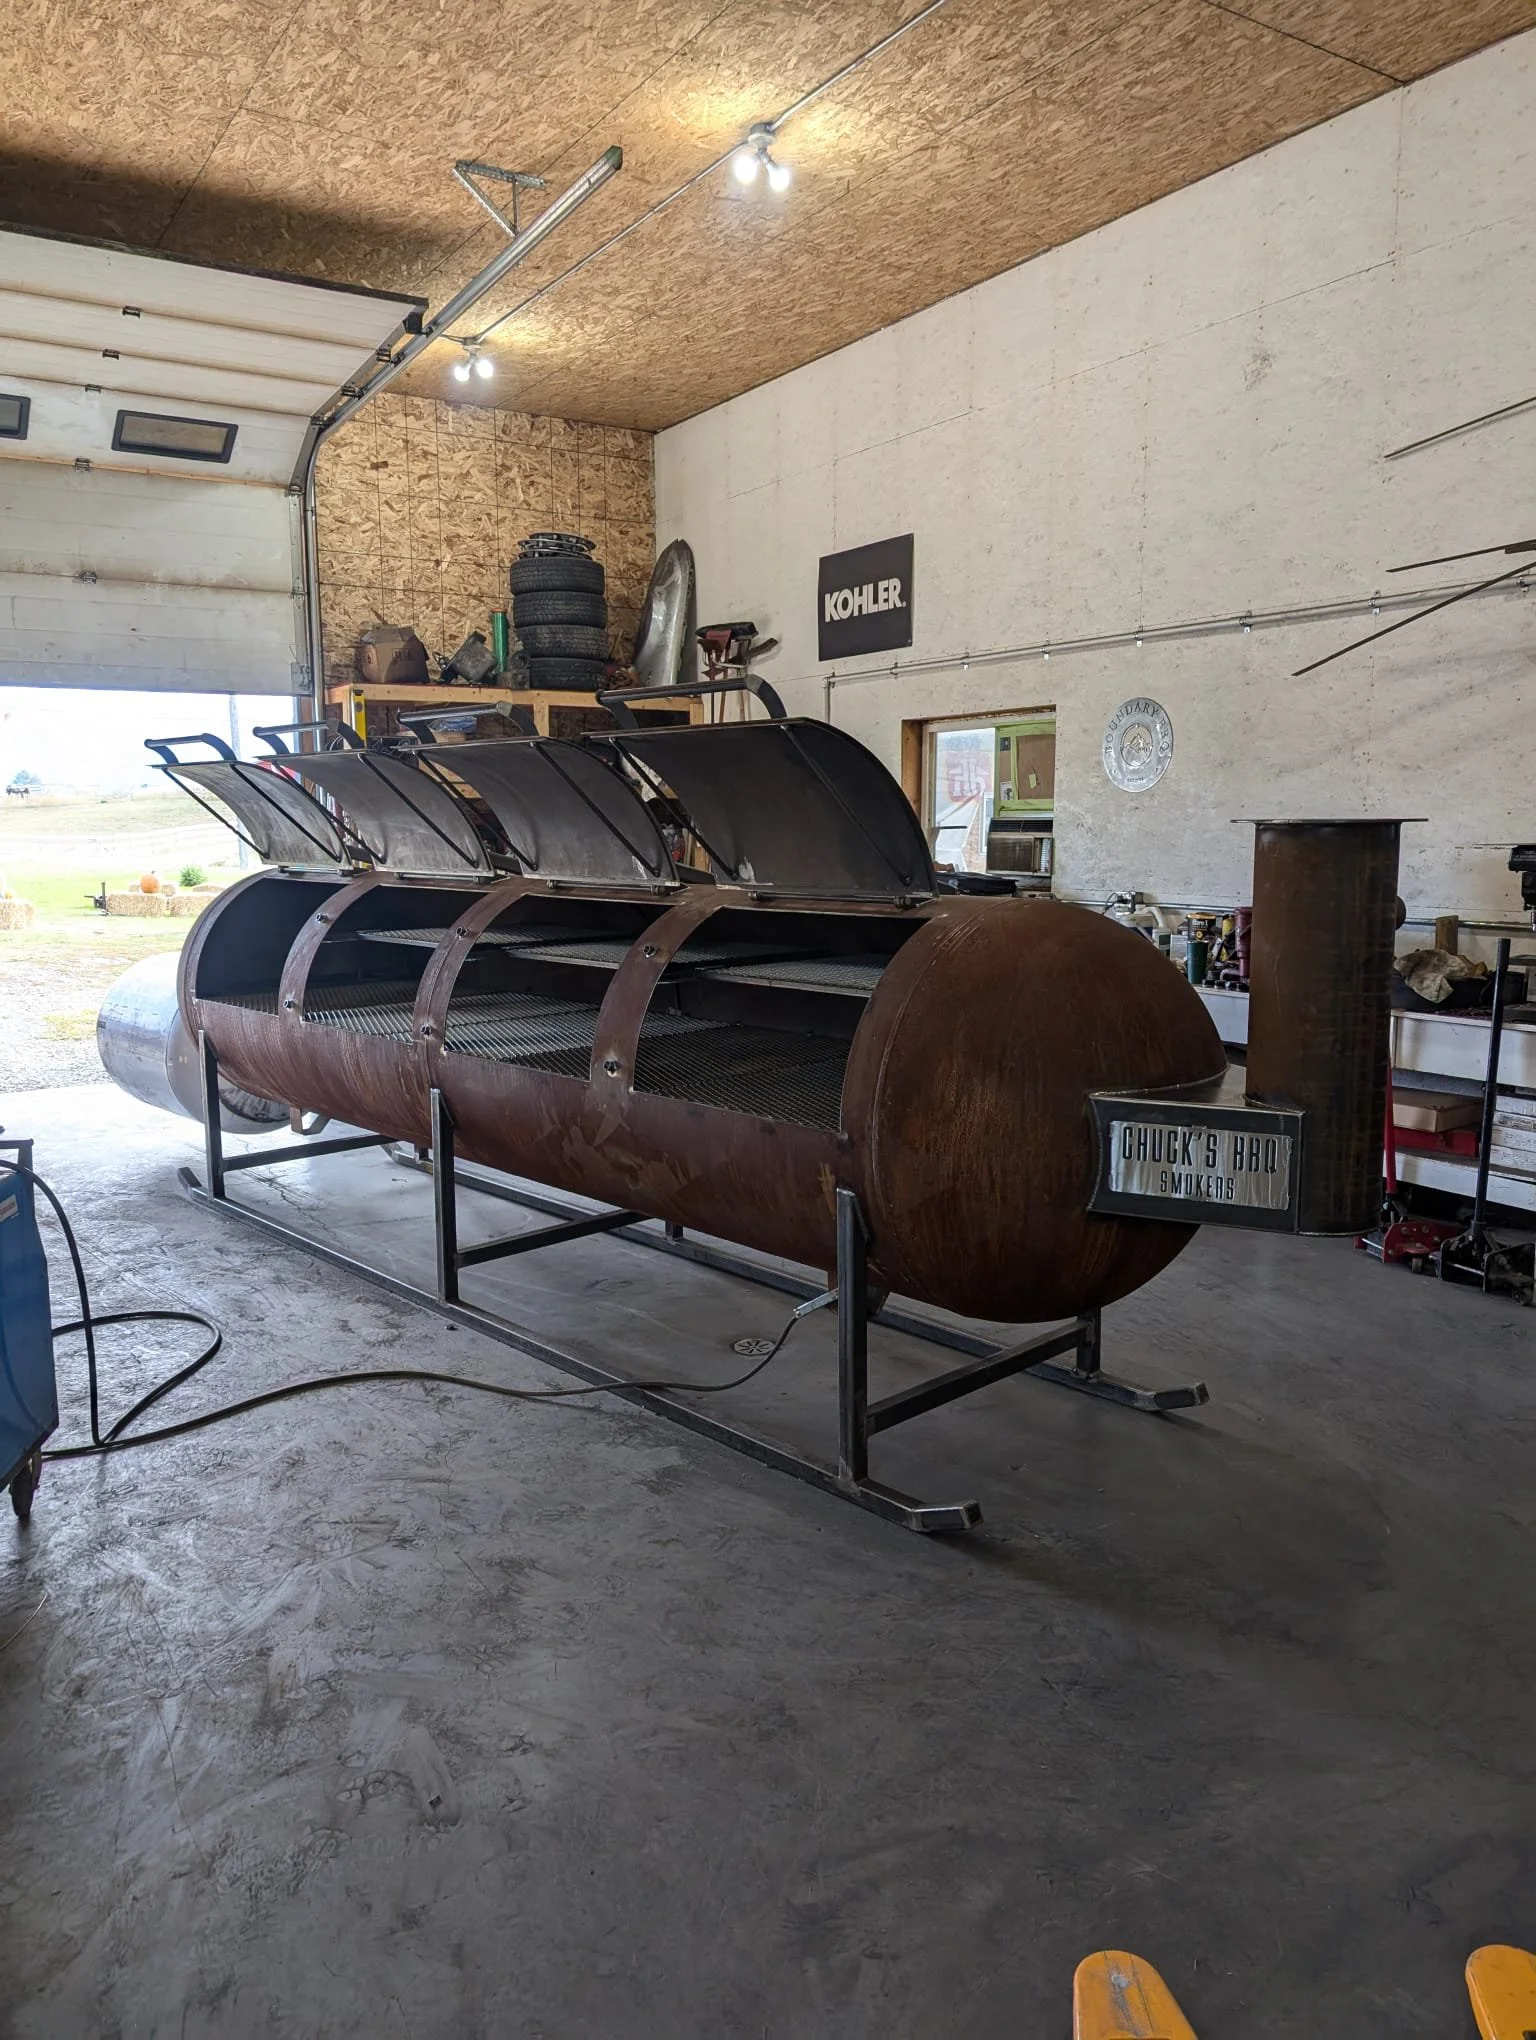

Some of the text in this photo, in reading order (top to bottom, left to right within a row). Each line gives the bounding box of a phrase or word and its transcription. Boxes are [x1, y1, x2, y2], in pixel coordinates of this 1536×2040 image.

[1122, 1126, 1279, 1174] CHUCK'S BBQ
[1160, 1170, 1234, 1200] SMOKERS
